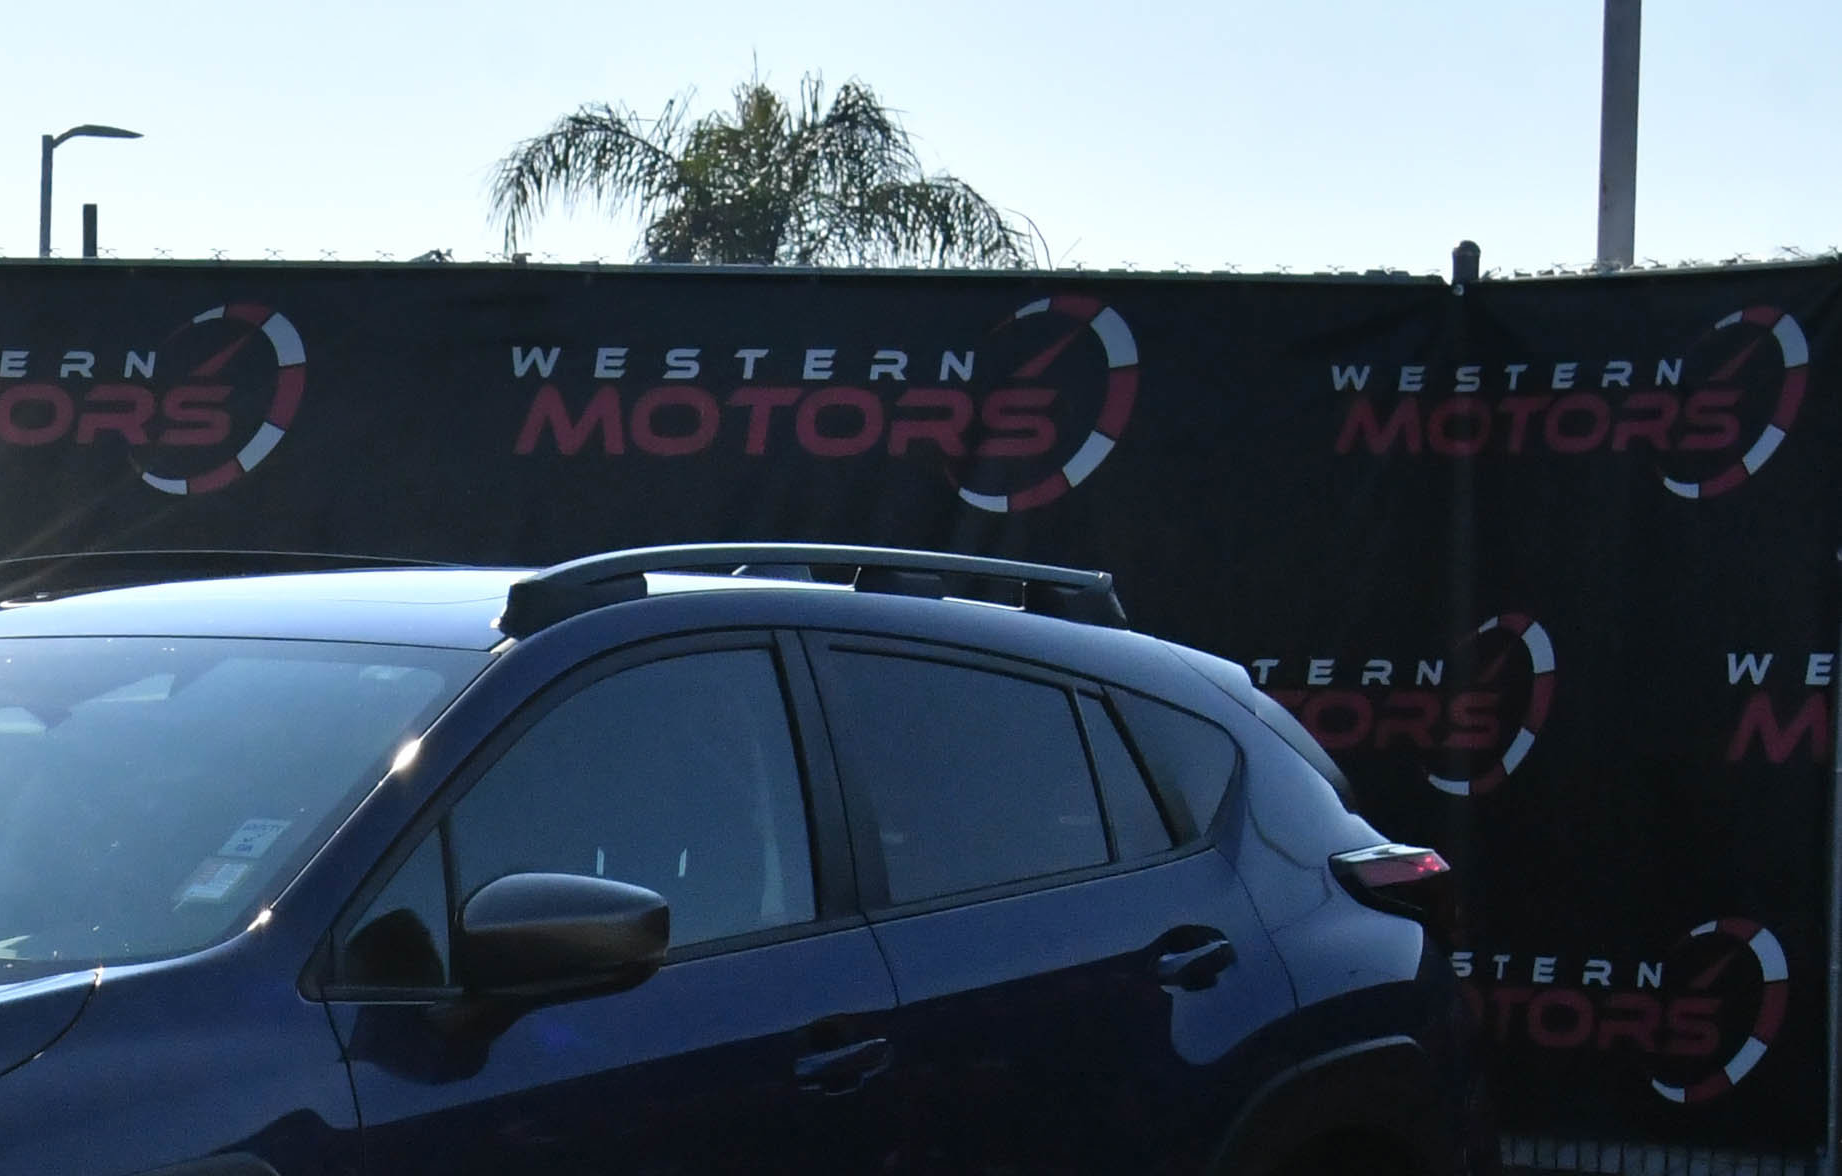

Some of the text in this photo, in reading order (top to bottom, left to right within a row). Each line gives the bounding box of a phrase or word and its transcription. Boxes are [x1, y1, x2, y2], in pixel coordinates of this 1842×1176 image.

[512, 346, 976, 382] WESTERN
[1331, 358, 1683, 393] WESTERN
[515, 386, 1058, 457] MOTORS
[1335, 391, 1743, 455] MOTORS
